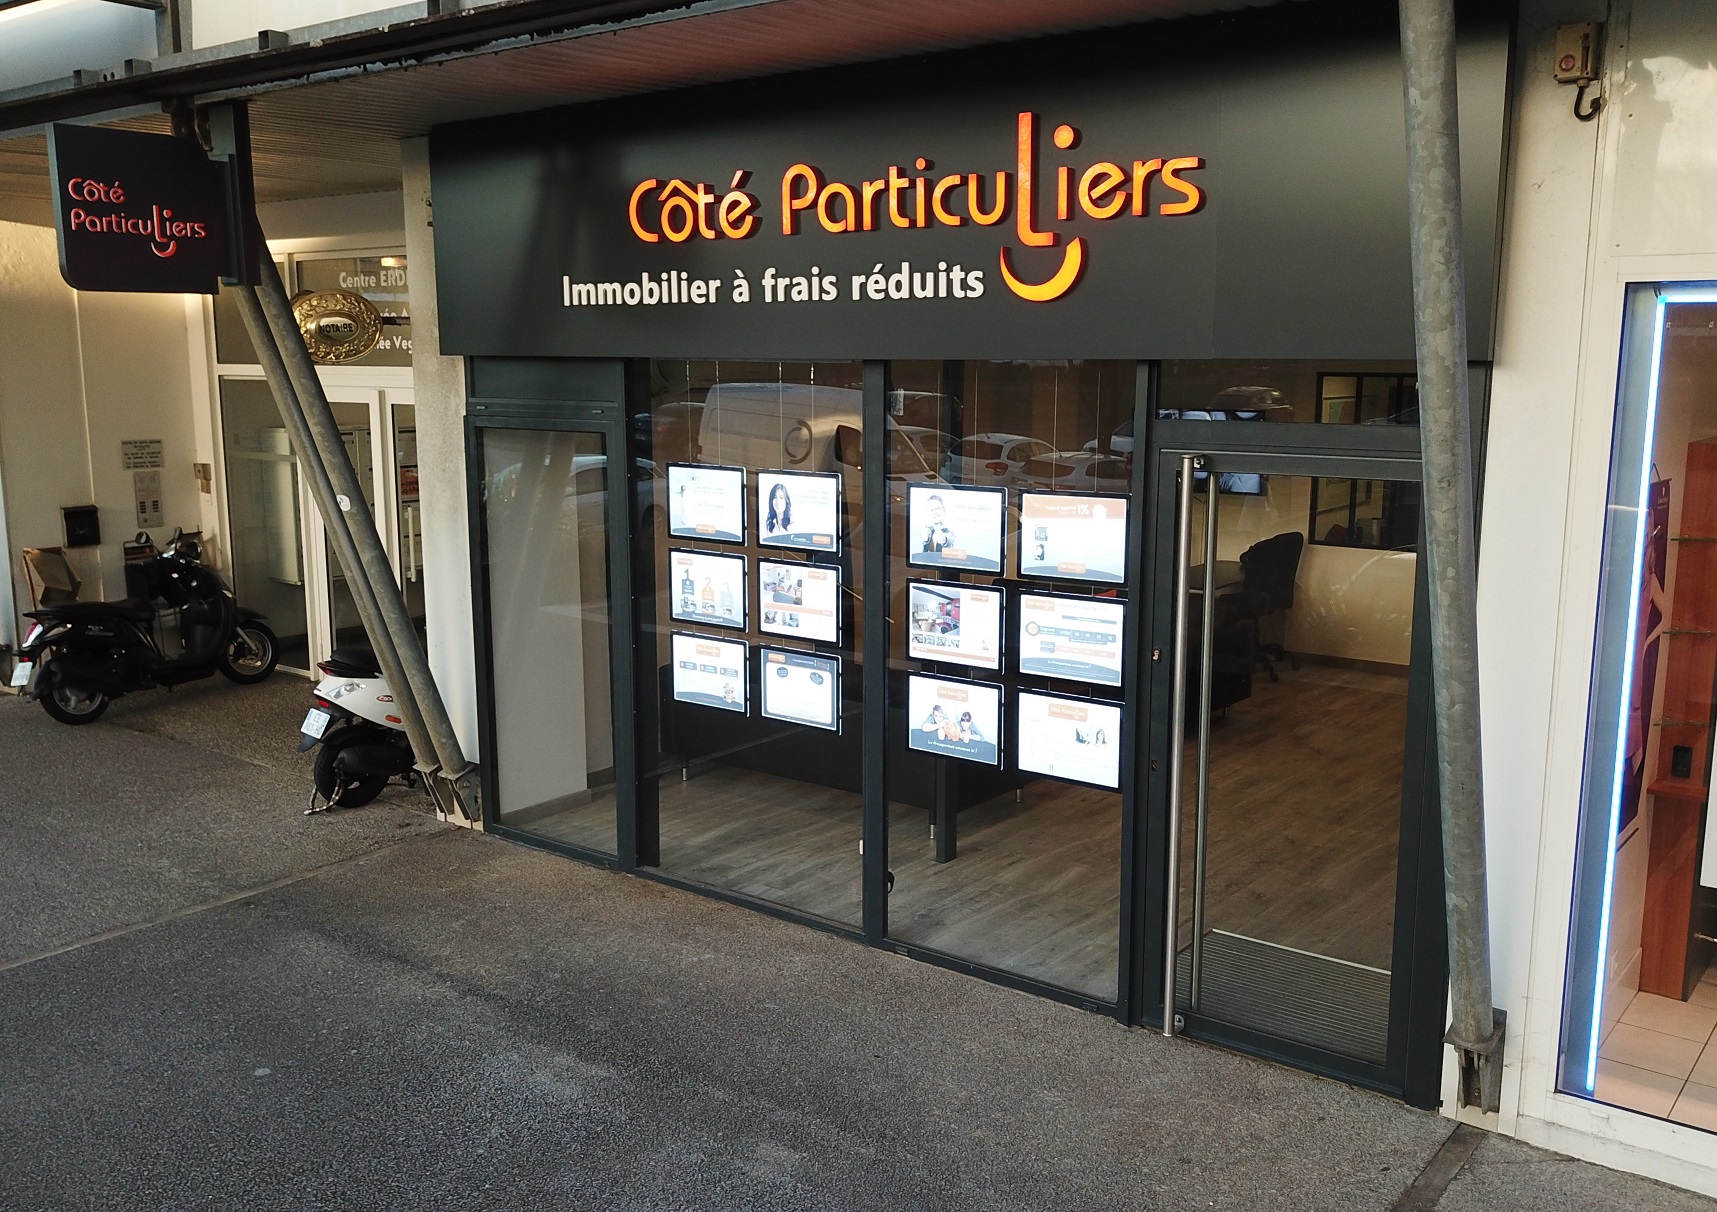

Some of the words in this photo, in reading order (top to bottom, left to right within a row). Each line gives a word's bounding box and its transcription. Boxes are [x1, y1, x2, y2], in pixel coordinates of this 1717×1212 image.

[68, 177, 125, 204] Côté
[628, 169, 754, 243] Côté
[781, 111, 1204, 247] Particuliers
[70, 204, 207, 244] Particuliers
[339, 272, 377, 289] Centre
[380, 269, 408, 287] ERD
[562, 272, 721, 307] Immobilier
[731, 269, 750, 304] à
[761, 266, 839, 303] frais
[852, 260, 985, 301] réduits
[319, 322, 354, 334] NOTAIRE
